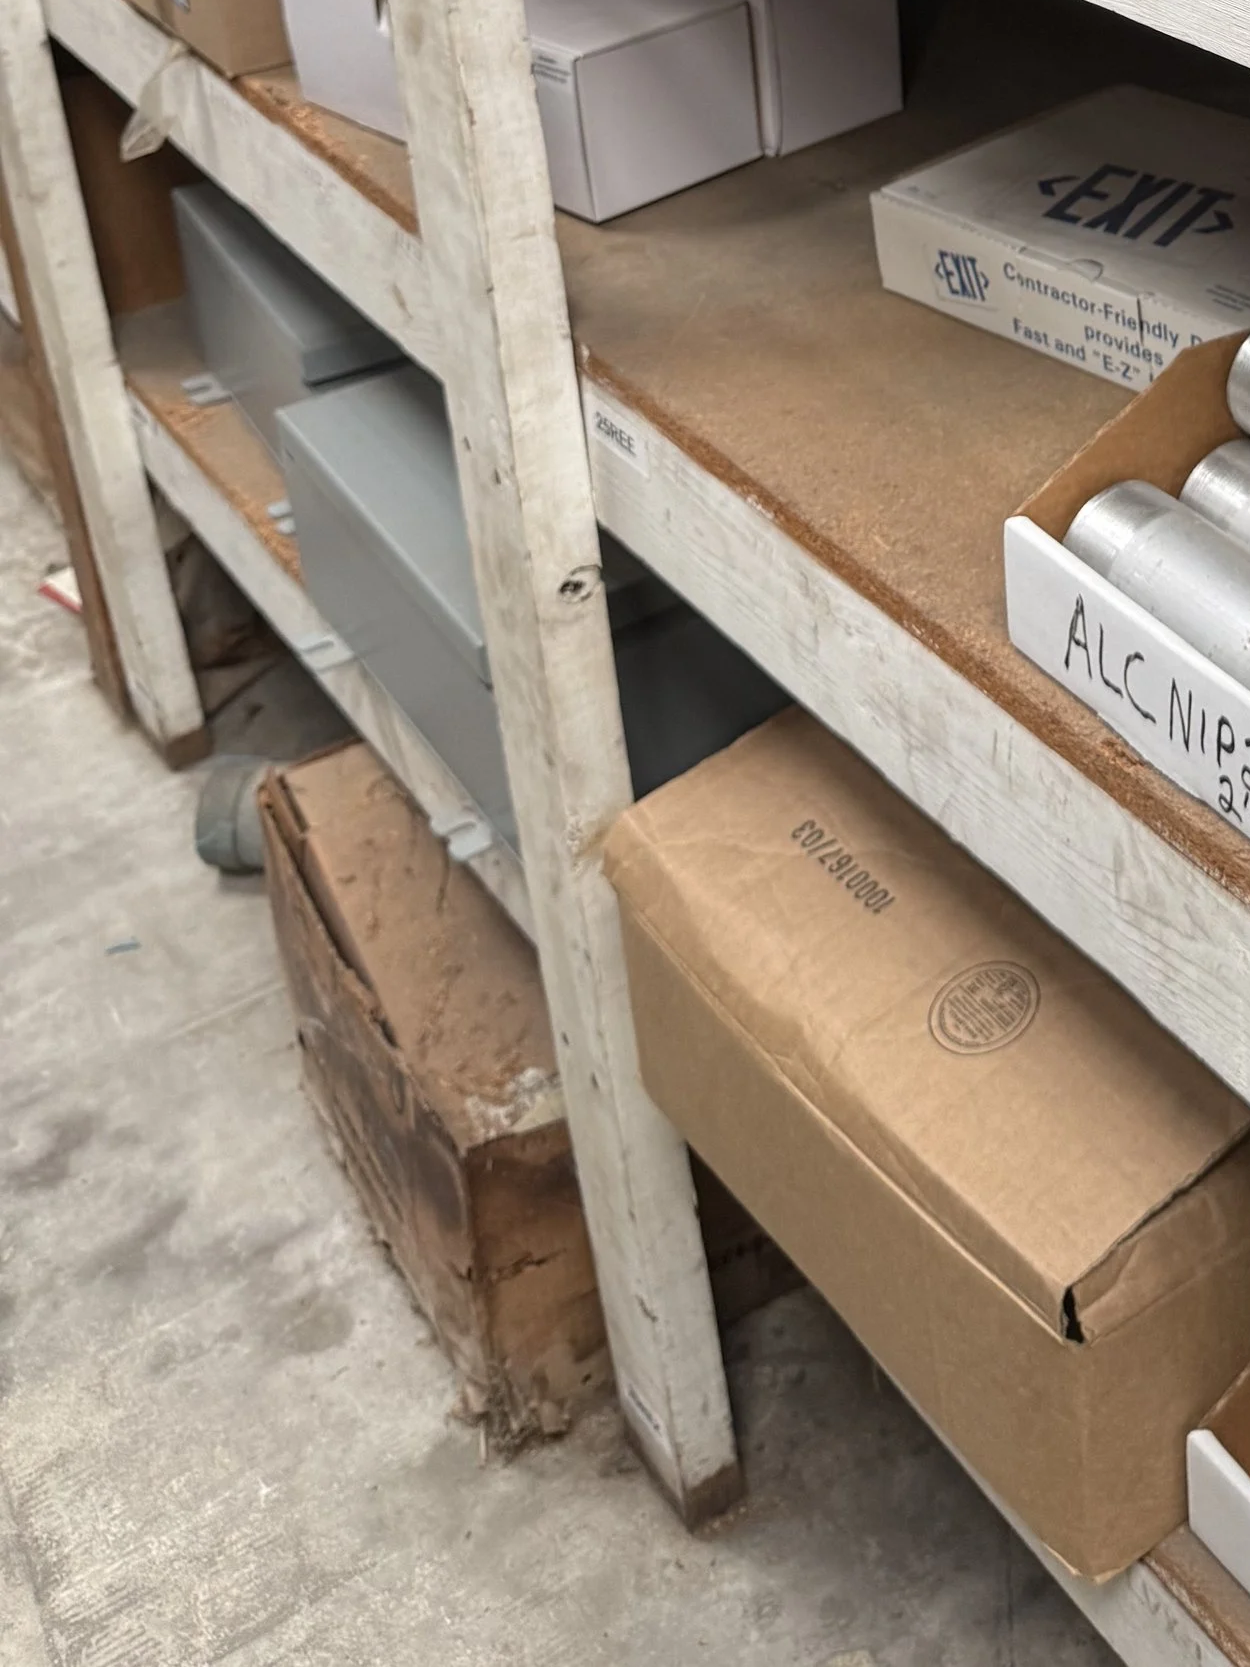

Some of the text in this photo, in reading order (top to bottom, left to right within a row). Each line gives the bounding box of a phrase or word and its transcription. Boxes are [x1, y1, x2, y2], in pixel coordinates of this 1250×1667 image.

[1042, 163, 1236, 248] EXIT
[938, 249, 986, 302] EXIT
[1002, 262, 1180, 348] Contractor-Friendly
[1012, 317, 1051, 348] Fast
[1054, 335, 1087, 362] and
[1083, 325, 1164, 367] provides
[593, 410, 637, 458] 25REE
[1063, 592, 1158, 724] ALC
[1169, 677, 1236, 768] NIP
[791, 819, 896, 914] 1000167/03
